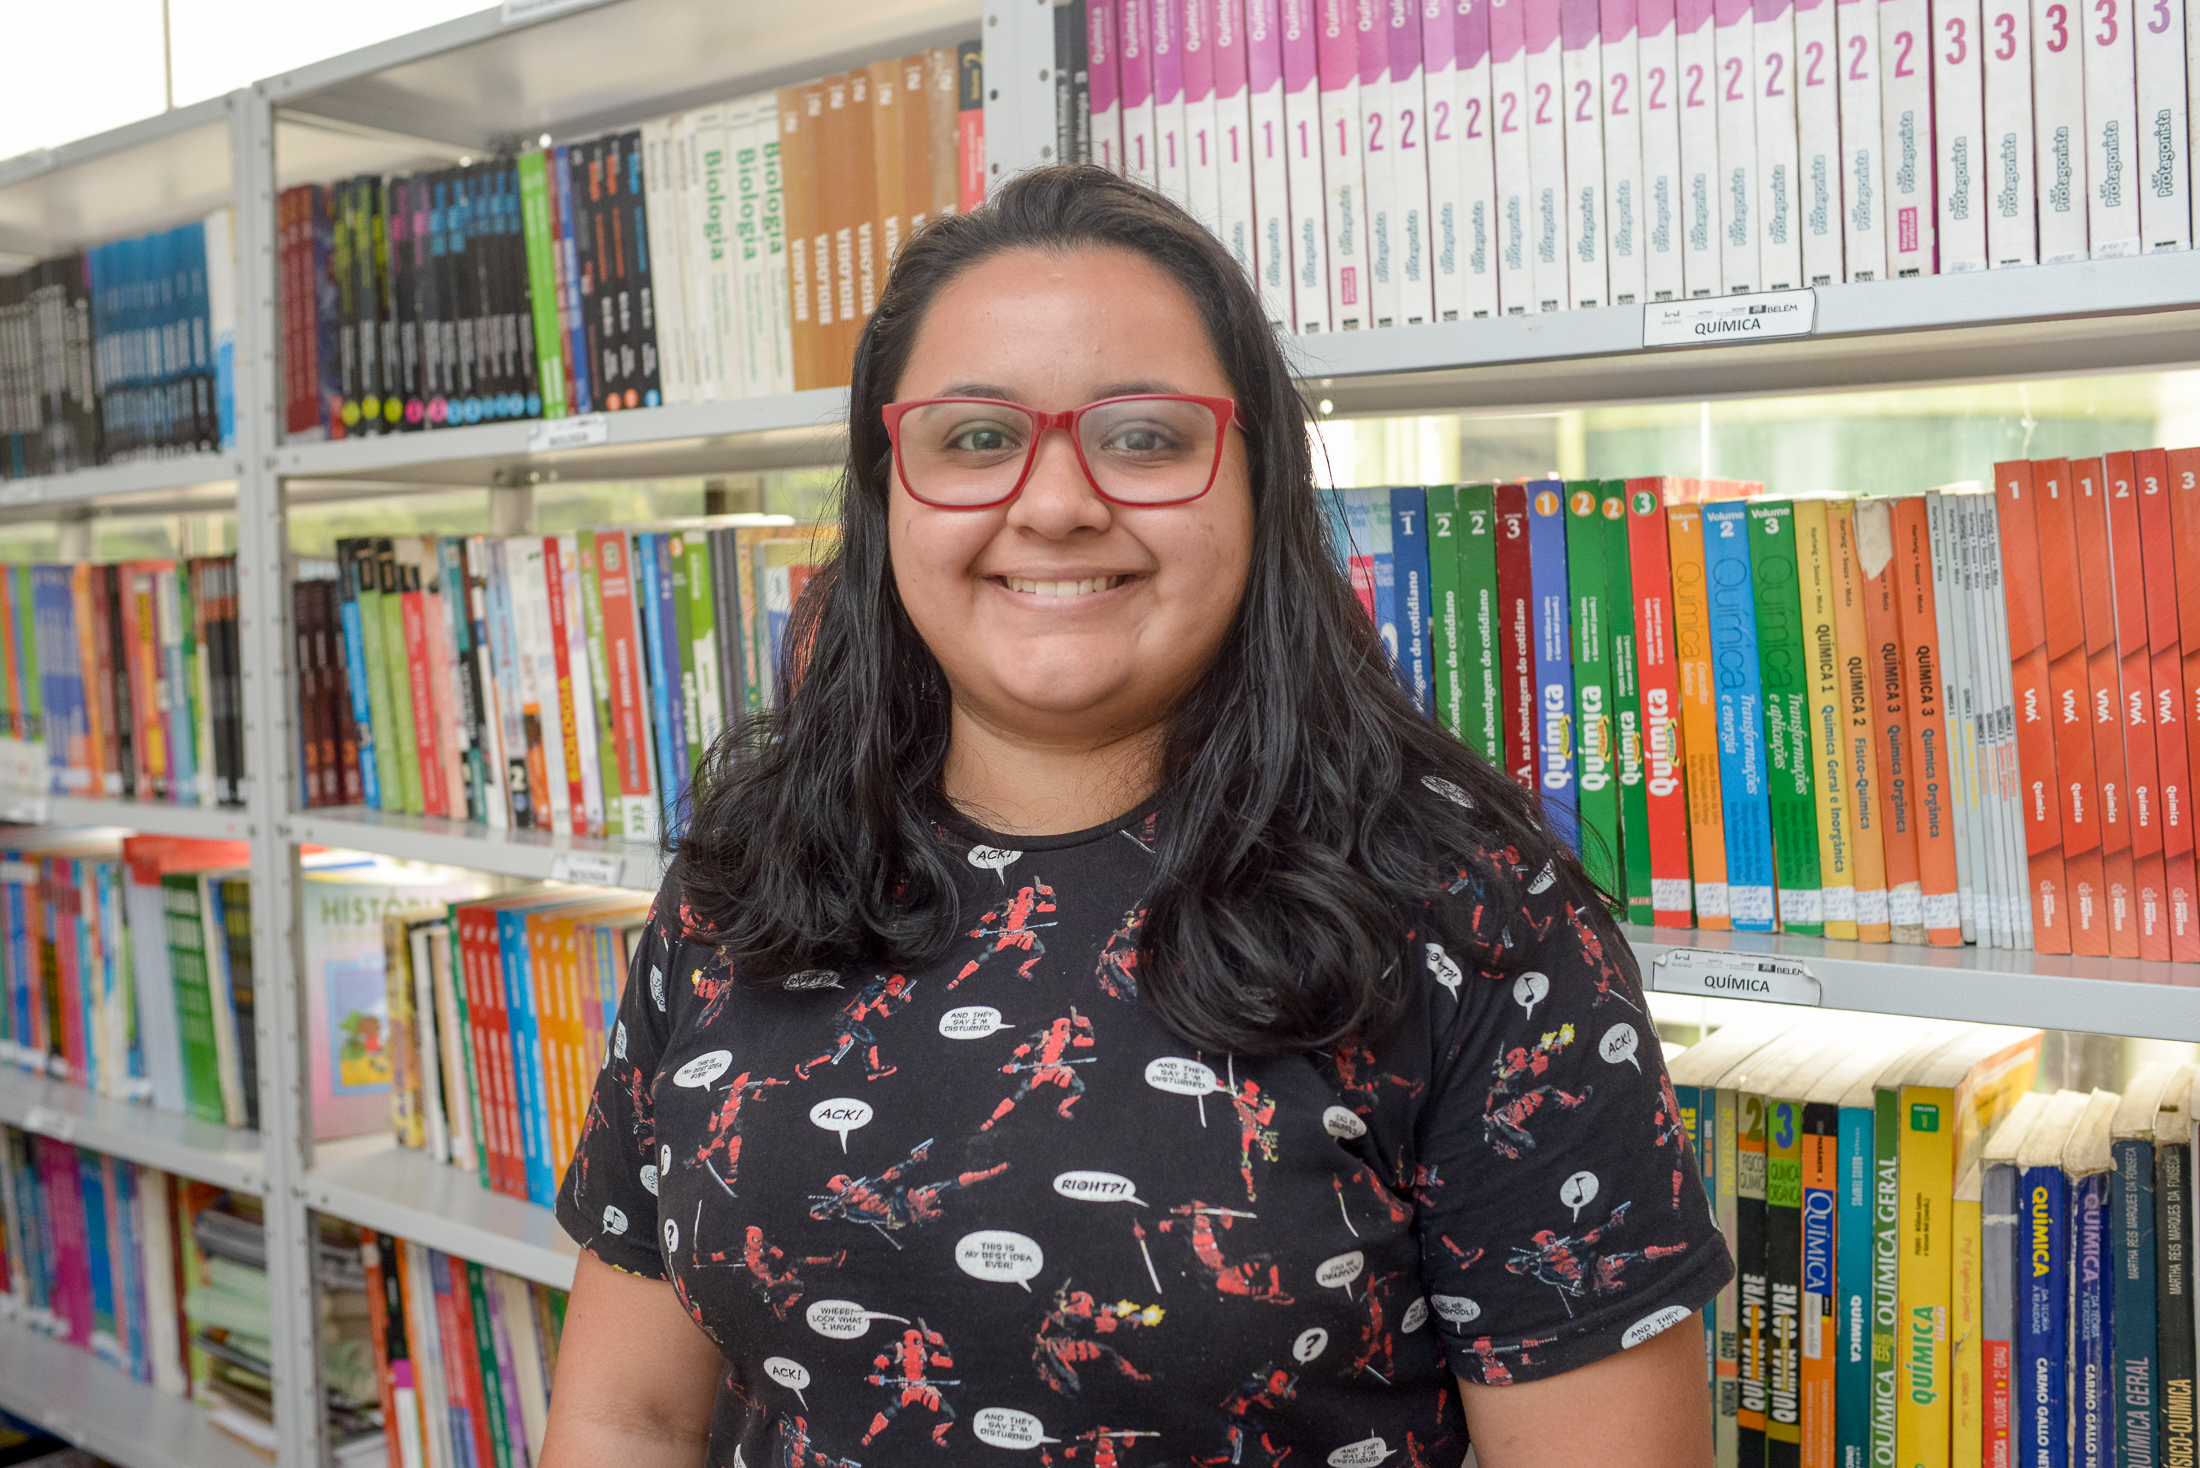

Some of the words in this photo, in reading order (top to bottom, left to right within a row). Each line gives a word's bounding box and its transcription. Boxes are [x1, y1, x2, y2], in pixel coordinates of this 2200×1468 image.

[1945, 17, 1967, 65] 3
[1994, 13, 2017, 61] 3
[2046, 4, 2068, 52] 3
[2095, 0, 2118, 46] 3
[1766, 53, 1785, 97] 2
[1848, 35, 1868, 80] 2
[1895, 31, 1914, 78] 2
[1575, 80, 1593, 122] 2
[1649, 67, 1666, 110] 2
[1368, 112, 1384, 152] 2
[1434, 101, 1450, 141] 2
[1501, 92, 1518, 133] 2
[1196, 129, 1207, 166] 1
[1262, 120, 1273, 158] 1
[1336, 118, 1347, 156] 1
[1899, 110, 1917, 194] Protagonista
[2154, 108, 2175, 198] Protagonista
[2052, 126, 2072, 213] Protagonista
[2102, 120, 2122, 208] Protagonista
[704, 151, 729, 261] Biologia
[737, 148, 763, 260] Biologia
[762, 142, 783, 255] Biologia
[791, 238, 809, 322] BIOLOGIA
[836, 228, 855, 320] BIOLOGIA
[1695, 318, 1761, 335] QUÍMICA
[1767, 304, 1798, 313] BELÉM
[2008, 480, 2020, 500] 1
[2114, 480, 2129, 498] 2
[2181, 471, 2196, 490] 3
[1471, 515, 1485, 534] 2
[1540, 494, 1550, 514] 1
[1638, 492, 1651, 514] 3
[1671, 512, 1698, 521] Volume
[1707, 511, 1745, 522] Volume
[1751, 507, 1790, 519] Volume
[1402, 516, 1414, 535] 1
[1437, 518, 1451, 537] 2
[1507, 519, 1520, 539] 3
[1681, 521, 1688, 532] 1
[1720, 521, 1734, 538] 2
[1765, 518, 1779, 534] 3
[1407, 571, 1420, 636] cotidiano
[1445, 591, 1456, 649] cotidiano
[1478, 589, 1490, 648] cotidiano
[1676, 561, 1704, 660] Química
[1713, 557, 1751, 691] Química
[1758, 555, 1797, 690] Química
[1410, 640, 1422, 657] do
[1515, 598, 1526, 655] cotidiano
[1447, 651, 1457, 668] do
[1481, 649, 1491, 667] do
[1517, 657, 1527, 674] do
[1816, 624, 1835, 681] QUÍMICA
[1881, 643, 1900, 701] QUÍMICA
[1916, 645, 1935, 704] QUÍMICA
[1483, 670, 1496, 739] abordagem
[1847, 656, 1866, 714] QUÍMICA
[1518, 676, 1531, 743] abordagem
[1721, 705, 1739, 754] energia
[1821, 704, 1838, 756] Química
[1853, 718, 1867, 727] 2
[1888, 704, 1901, 713] 3
[1922, 708, 1934, 717] 3
[1522, 744, 1531, 760] na
[1741, 694, 1760, 795] Transformações
[1768, 704, 1788, 769] aplicações
[1788, 693, 1809, 795] Transformações
[1887, 724, 1903, 775] Química
[1920, 728, 1937, 780] Química
[1827, 759, 1841, 793] Geral
[1854, 737, 1871, 830] Físico-Química
[1830, 796, 1839, 804] e
[1891, 779, 1908, 834] Orgânica
[1924, 783, 1942, 838] Orgânica
[2032, 781, 2046, 821] Química
[2165, 785, 2180, 826] Química
[1829, 807, 1845, 873] Inorgânica
[1704, 975, 1770, 993] QUÍMICA
[1607, 1030, 1632, 1056] ACK!
[818, 1107, 863, 1123] ACK!
[1745, 1097, 1763, 1143] 2
[1775, 1103, 1794, 1150] 3
[1722, 1108, 1736, 1195] PROFESSOR
[2125, 1147, 2137, 1180] FONSECA
[1061, 1179, 1127, 1194] RIGHT?!
[1877, 1156, 1897, 1223] GERAL
[2126, 1181, 2138, 1192] DA
[2032, 1186, 2053, 1278] QUÍMICA
[2126, 1193, 2138, 1228] MARQUES
[965, 1251, 979, 1259] MY
[982, 1251, 1006, 1260] BEST
[1010, 1254, 1033, 1263] IDEA
[981, 1242, 1002, 1251] THIS
[1005, 1243, 1015, 1251] IS
[1804, 1191, 1833, 1289] QUÍMICA
[2082, 1193, 2103, 1283] QUÍMICA
[2126, 1230, 2139, 1248] REIS
[1873, 1229, 1896, 1325] QUÍMICA
[2128, 1249, 2140, 1280] MARTHA
[838, 1316, 862, 1324] WHAT
[1742, 1273, 1766, 1330] COVRE
[1772, 1283, 1797, 1340] COVRE
[1304, 1333, 1321, 1357] ?
[1631, 1323, 1651, 1339] AND
[1656, 1309, 1679, 1325] THEY
[1850, 1294, 1864, 1363] QUÍMICA
[772, 1366, 801, 1380] ACK!
[1905, 1305, 1939, 1406] QUÍMICA
[2036, 1357, 2048, 1404] CARMO
[2085, 1363, 2096, 1411] CARMO
[2125, 1356, 2150, 1406] GERAL
[1871, 1370, 1894, 1465] QUÍMICA
[2036, 1406, 2049, 1447] GALLO
[2085, 1413, 2097, 1454] GALLO
